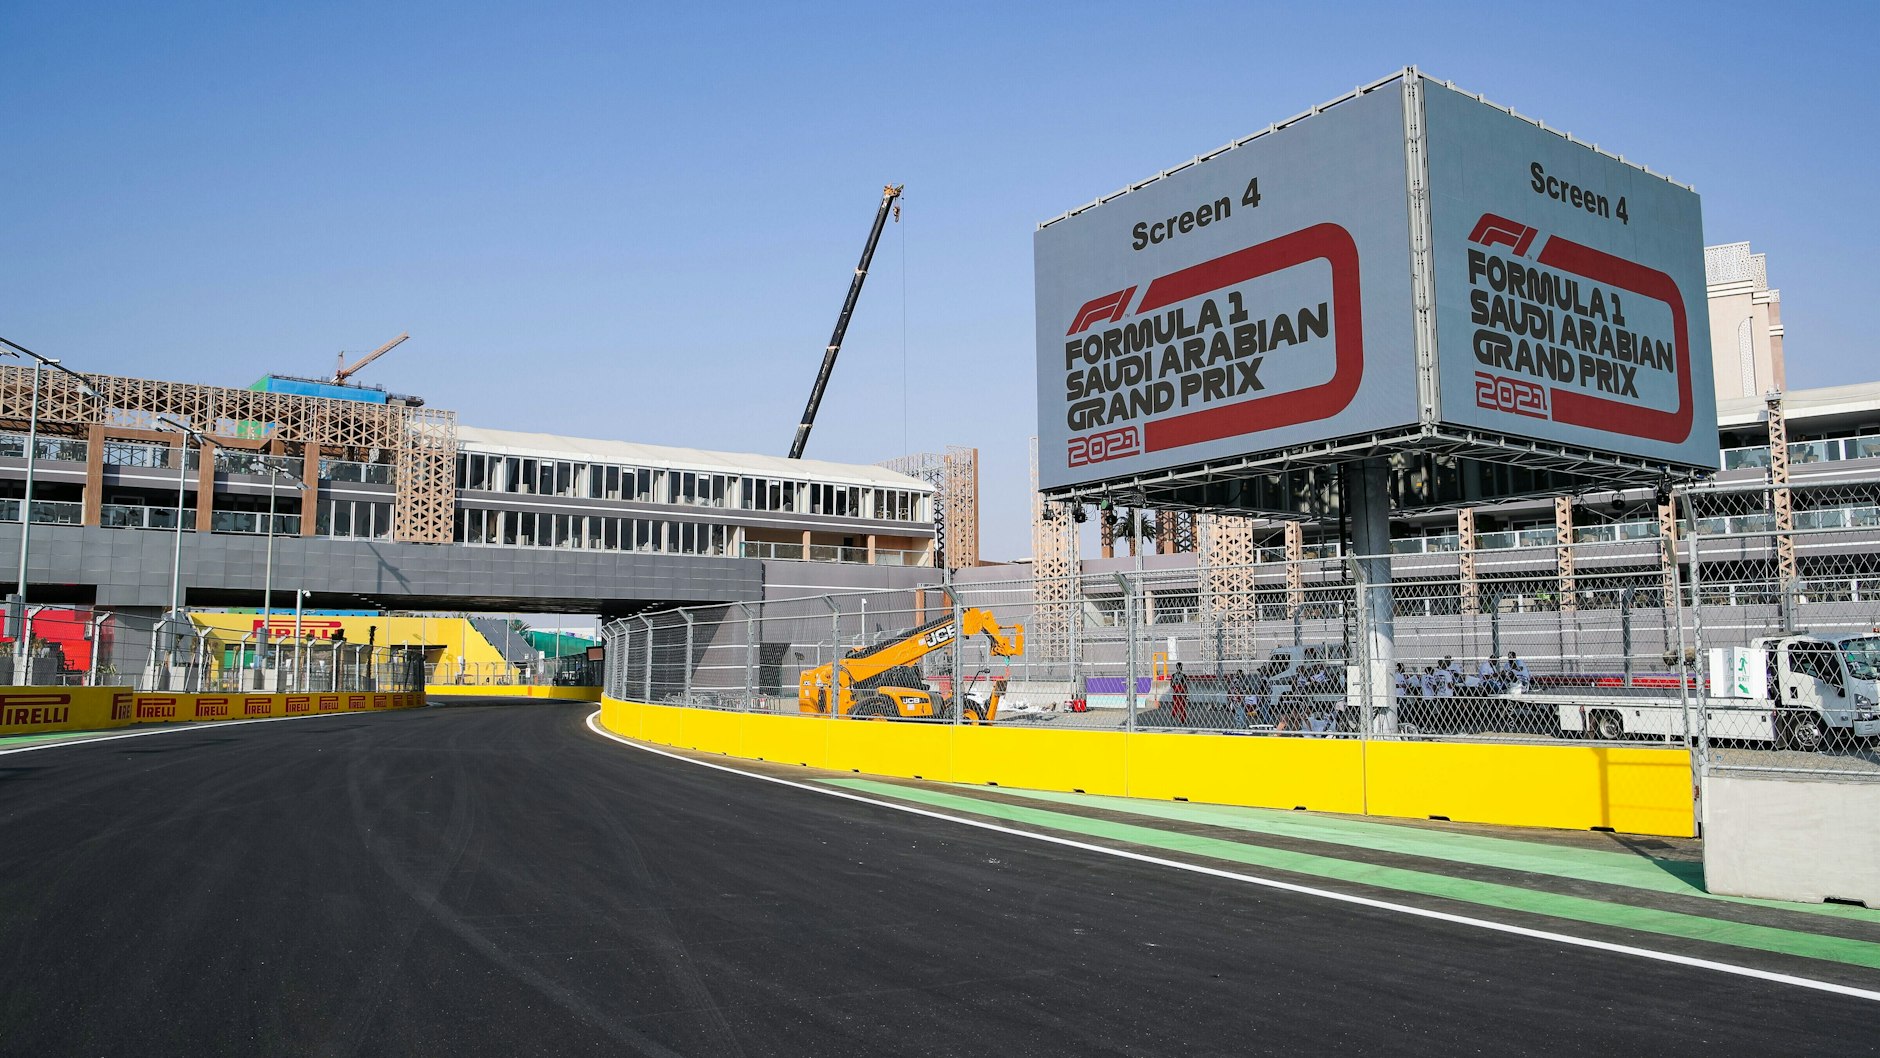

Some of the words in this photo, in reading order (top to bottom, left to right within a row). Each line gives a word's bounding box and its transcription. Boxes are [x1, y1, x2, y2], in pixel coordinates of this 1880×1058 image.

[1132, 196, 1231, 251] Screen
[1241, 176, 1261, 208] 4
[1530, 161, 1610, 220] Screen
[1615, 196, 1629, 226] 4
[1468, 213, 1539, 258] F1
[1066, 284, 1138, 336] F1
[1467, 247, 1609, 323] FORMULA
[1610, 292, 1626, 328] 1
[1065, 298, 1223, 371] FORMULA
[1228, 290, 1249, 326] 1
[1066, 350, 1153, 402] SAUDI
[1158, 302, 1329, 379] ARABIAN
[1470, 288, 1556, 344] SAUDI
[1559, 314, 1674, 374] ARABIAN
[1472, 328, 1577, 384] GRAND
[1578, 353, 1640, 399] PRIX
[1067, 380, 1175, 432] GRAND
[1180, 356, 1266, 408] PRIX
[1475, 371, 1548, 420] 2021
[1069, 426, 1140, 468] 2021
[0, 694, 71, 726] PIRELLI
[136, 698, 177, 718] PIRELLI
[195, 698, 228, 717] PIRELLI
[244, 698, 272, 715] PIRELLI
[286, 696, 310, 713] PIRELLI
[319, 696, 339, 711] PIRELLI
